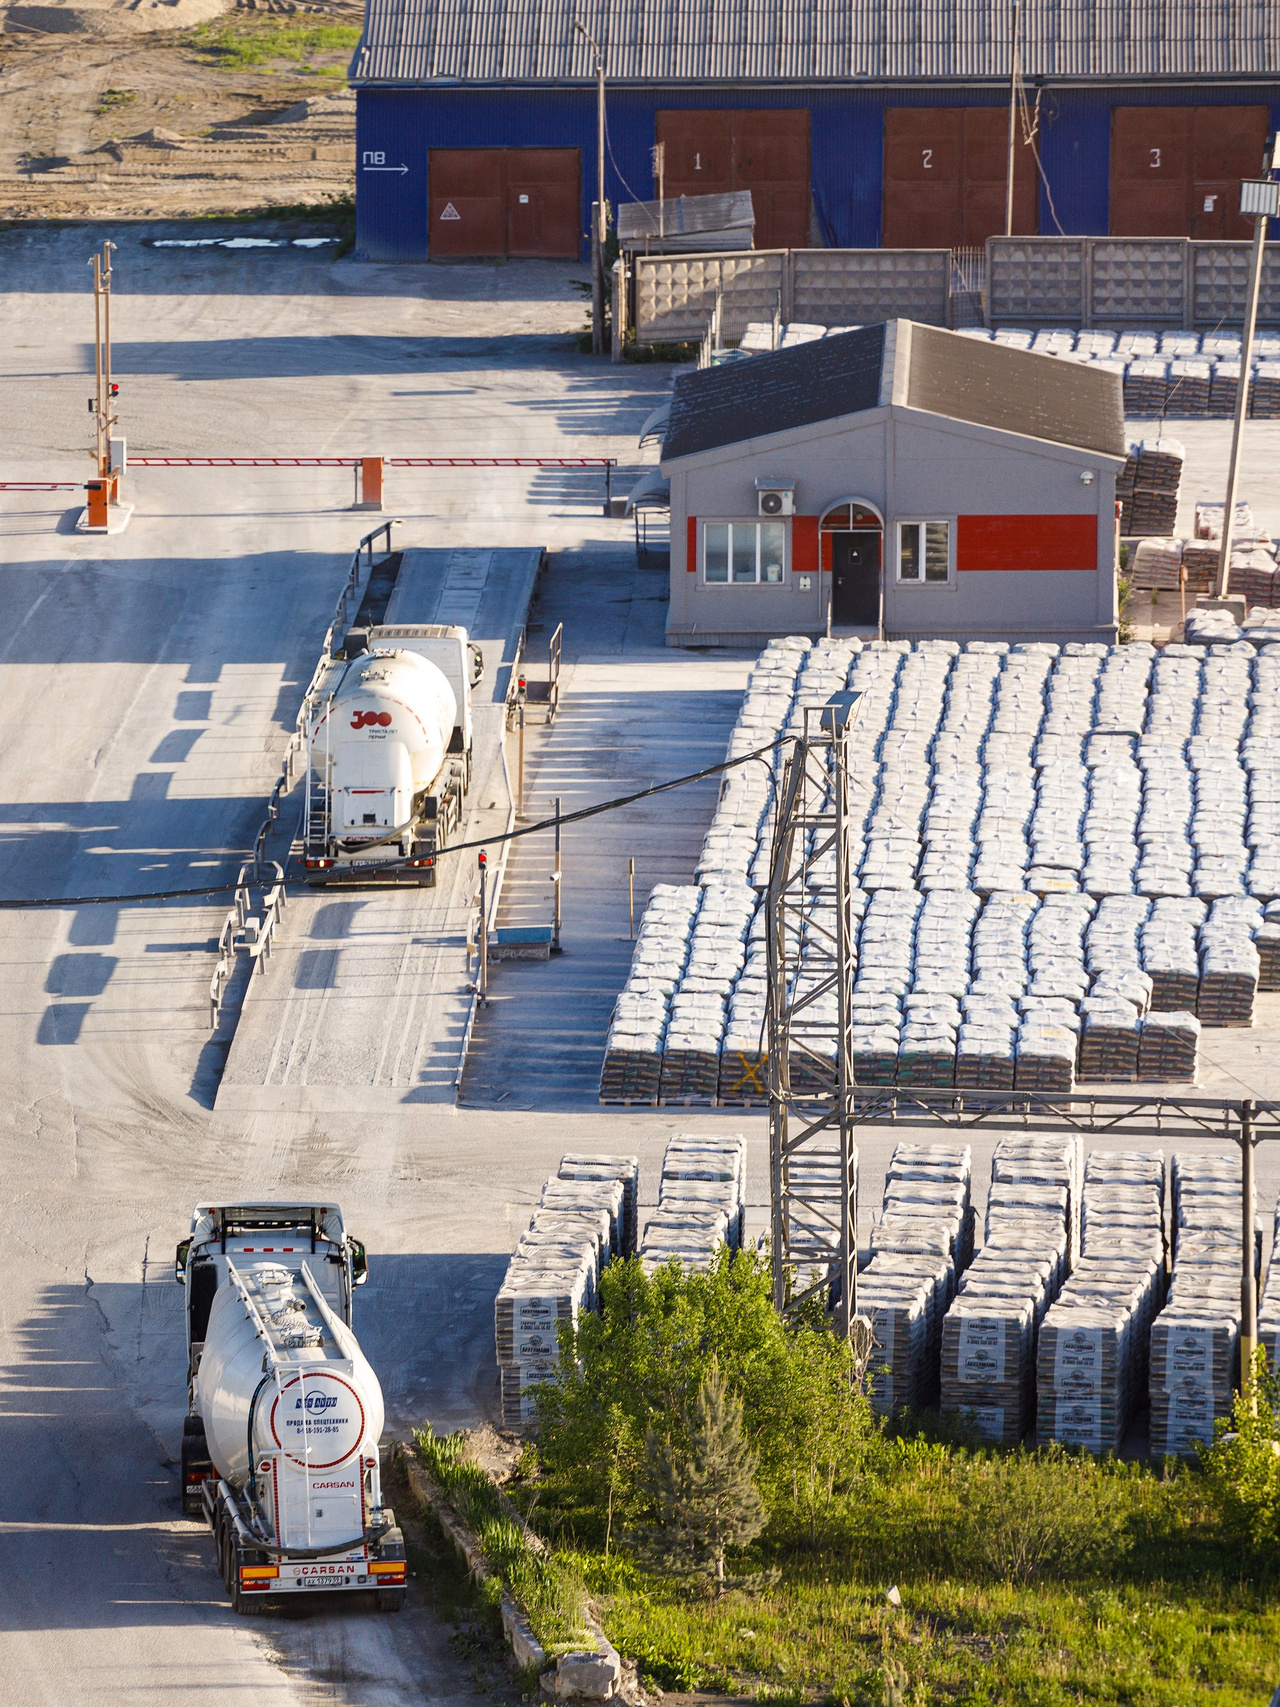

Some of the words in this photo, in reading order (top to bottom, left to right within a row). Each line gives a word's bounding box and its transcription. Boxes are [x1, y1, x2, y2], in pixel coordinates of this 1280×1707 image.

[362, 151, 386, 165] ПВ
[693, 152, 703, 170] 1
[921, 149, 933, 168] 2
[1149, 148, 1161, 168] 3
[350, 710, 393, 730] 300
[312, 1481, 355, 1490] CARSAN
[301, 1565, 356, 1575] CARSAN
